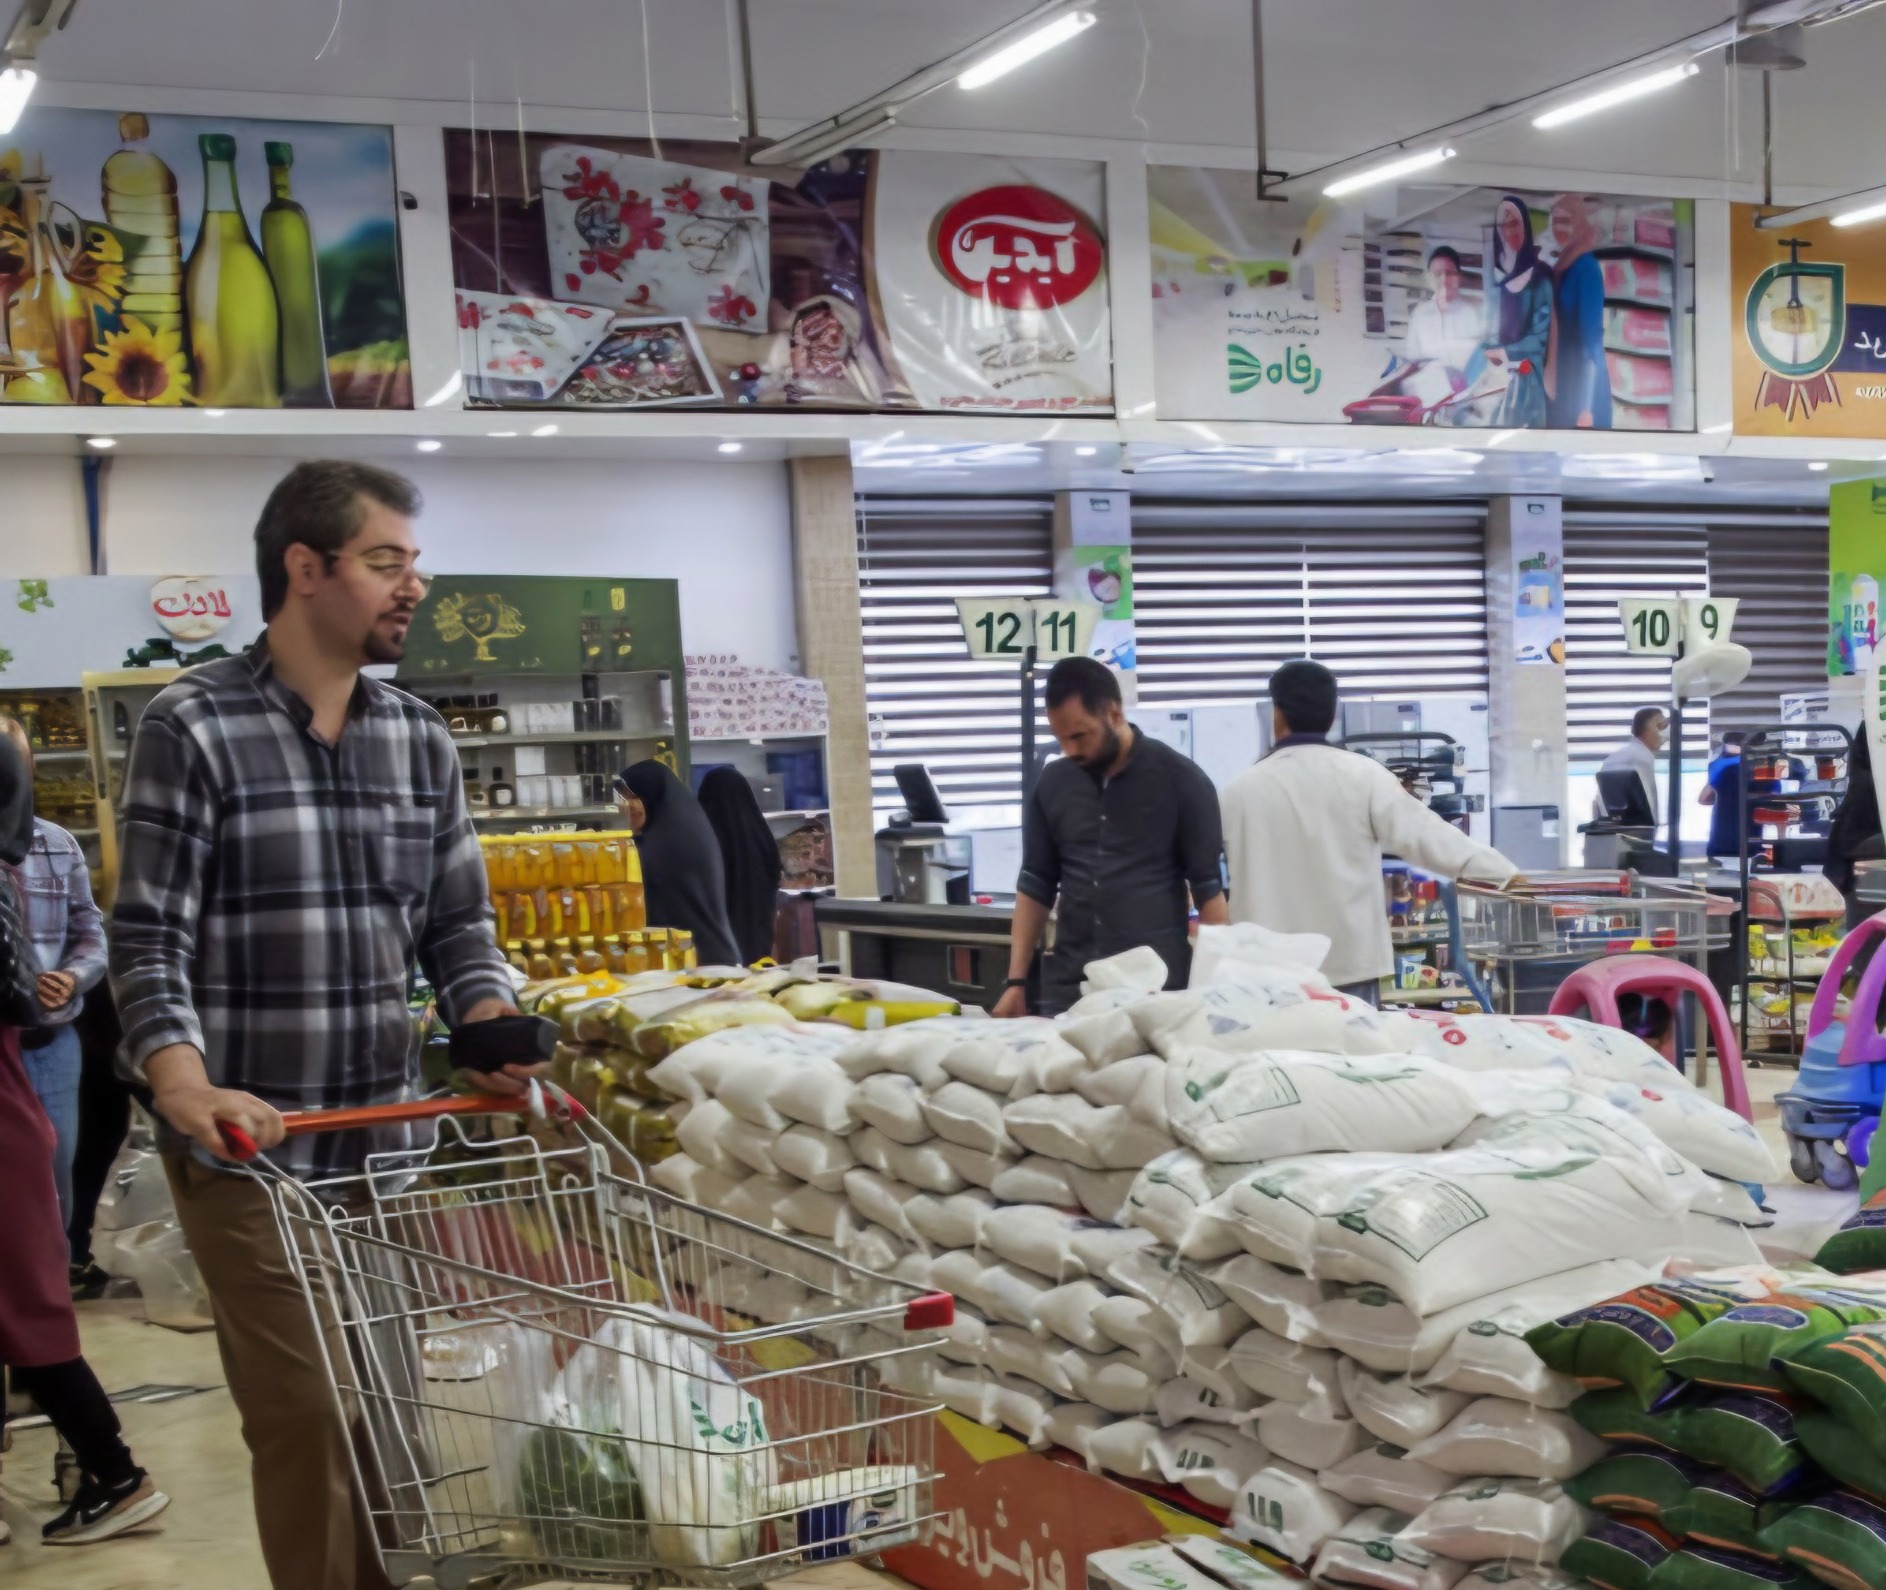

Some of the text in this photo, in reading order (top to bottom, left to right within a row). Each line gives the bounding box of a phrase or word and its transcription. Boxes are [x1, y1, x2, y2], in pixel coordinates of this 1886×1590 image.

[1266, 343, 1322, 395] رفاه
[975, 611, 1023, 654] 12
[1040, 610, 1077, 654] 11
[1632, 609, 1671, 648] 10
[1700, 603, 1719, 641] 9
